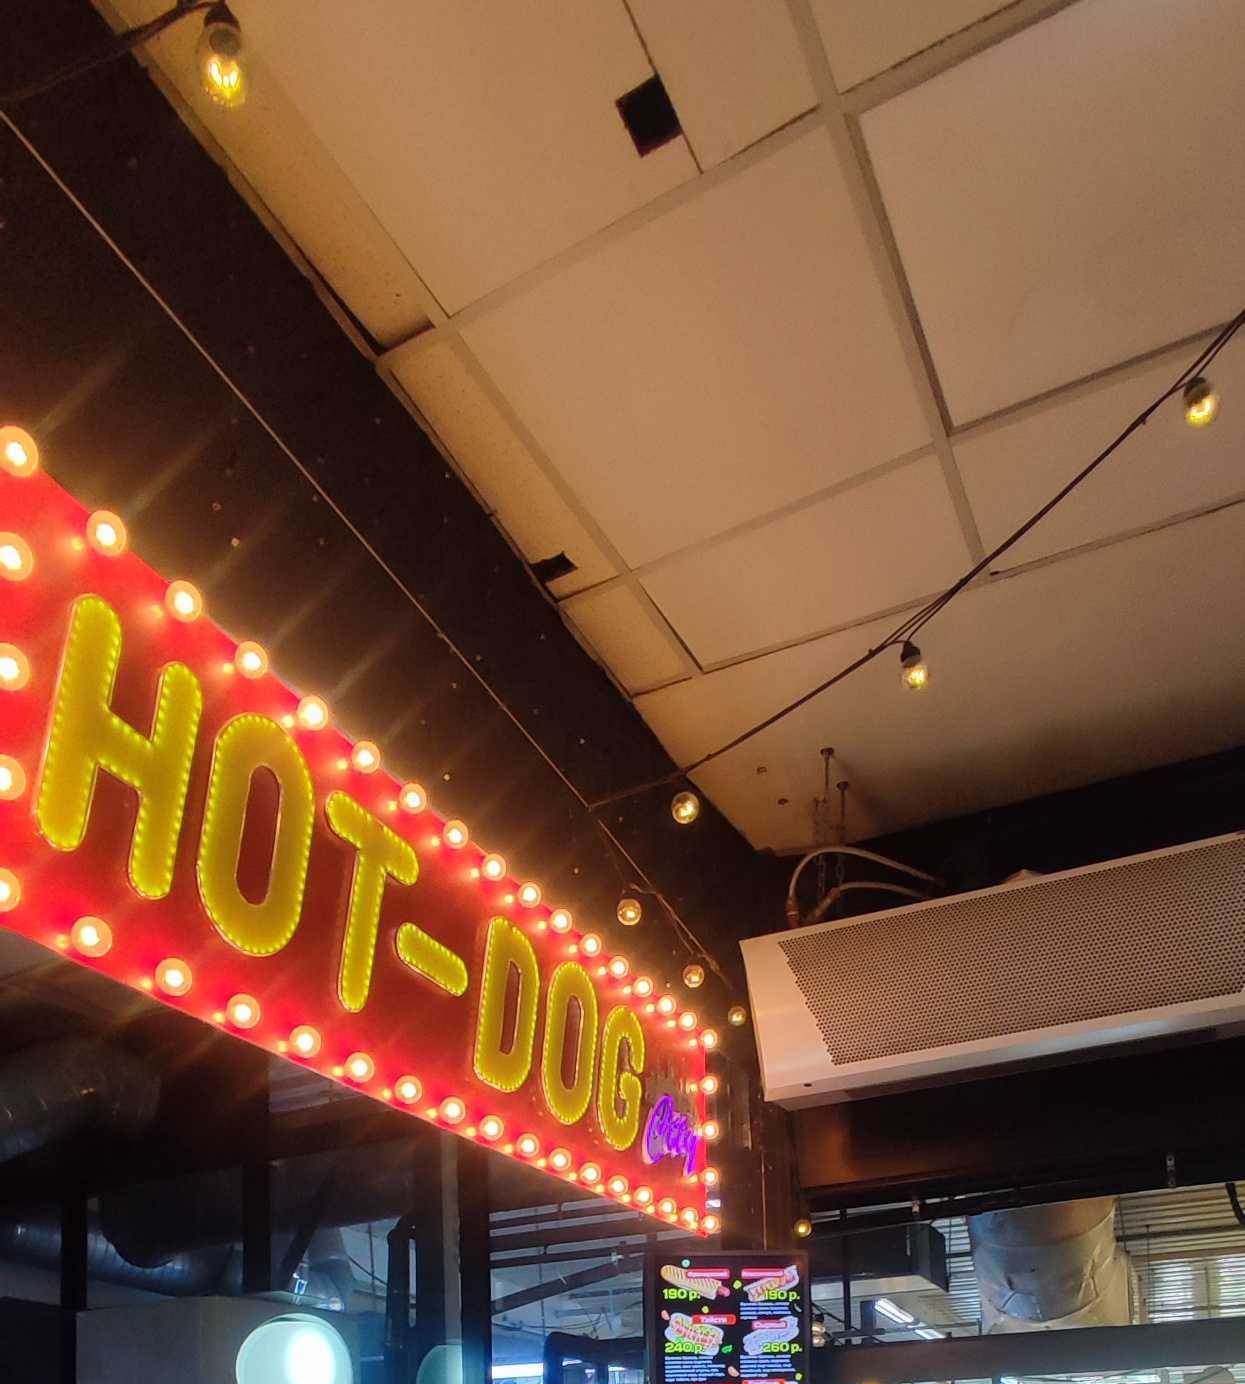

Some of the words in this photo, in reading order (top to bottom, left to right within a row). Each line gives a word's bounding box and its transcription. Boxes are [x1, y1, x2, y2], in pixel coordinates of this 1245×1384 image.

[33, 593, 647, 1152] HOT-DOG
[642, 1094, 700, 1177] City
[662, 1288, 688, 1300] 190
[765, 1290, 787, 1300] 190
[664, 1342, 692, 1353] 240
[762, 1342, 790, 1353] 260
